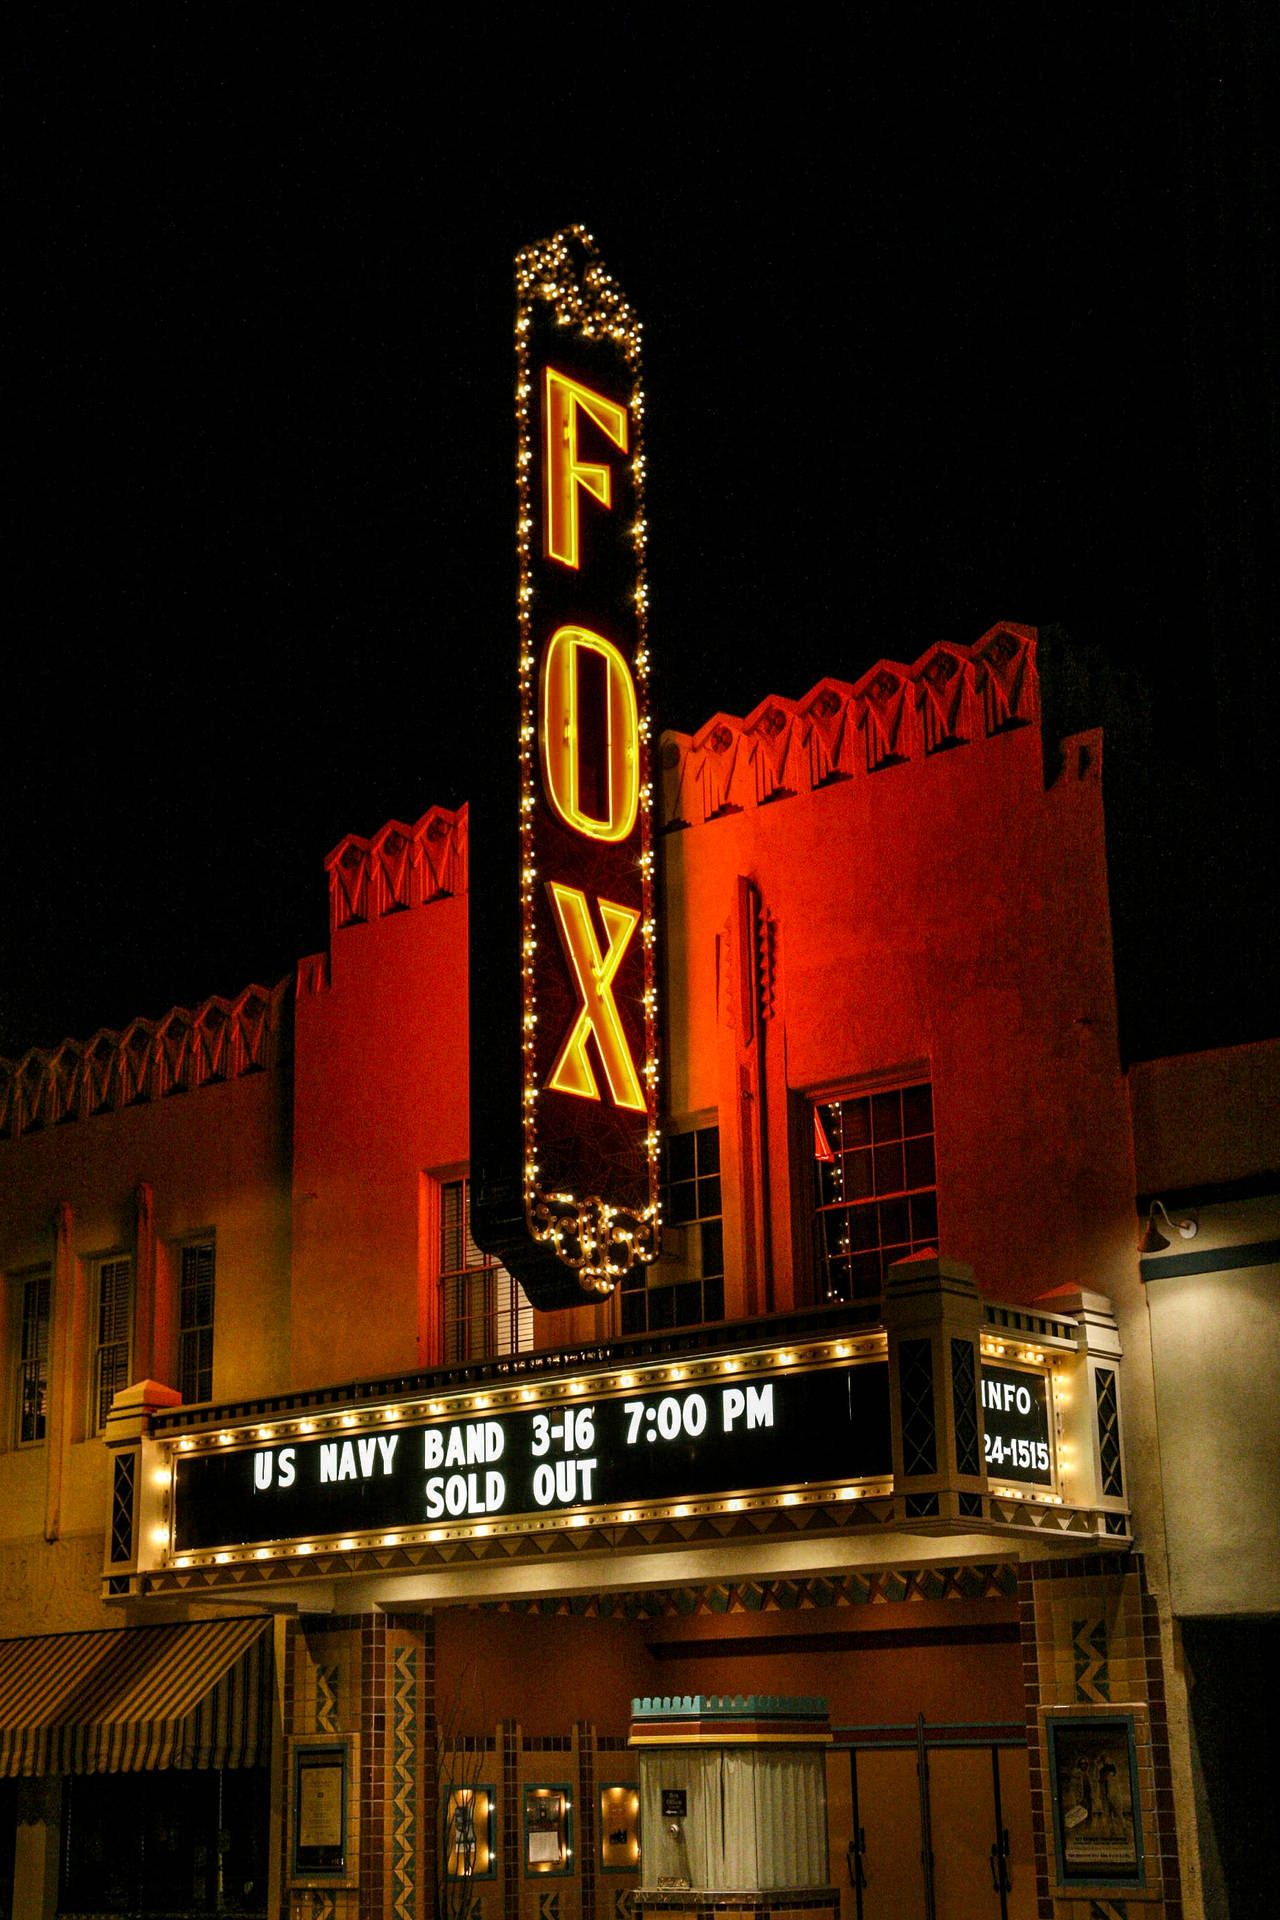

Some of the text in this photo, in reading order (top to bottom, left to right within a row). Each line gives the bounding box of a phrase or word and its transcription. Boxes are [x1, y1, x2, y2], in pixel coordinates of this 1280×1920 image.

[545, 366, 647, 1113] FOX
[254, 1383, 774, 1490] US NAVY BAND 3-16 7:00 PM
[980, 1379, 1031, 1415] INFO
[425, 1458, 597, 1519] SOLD OUT
